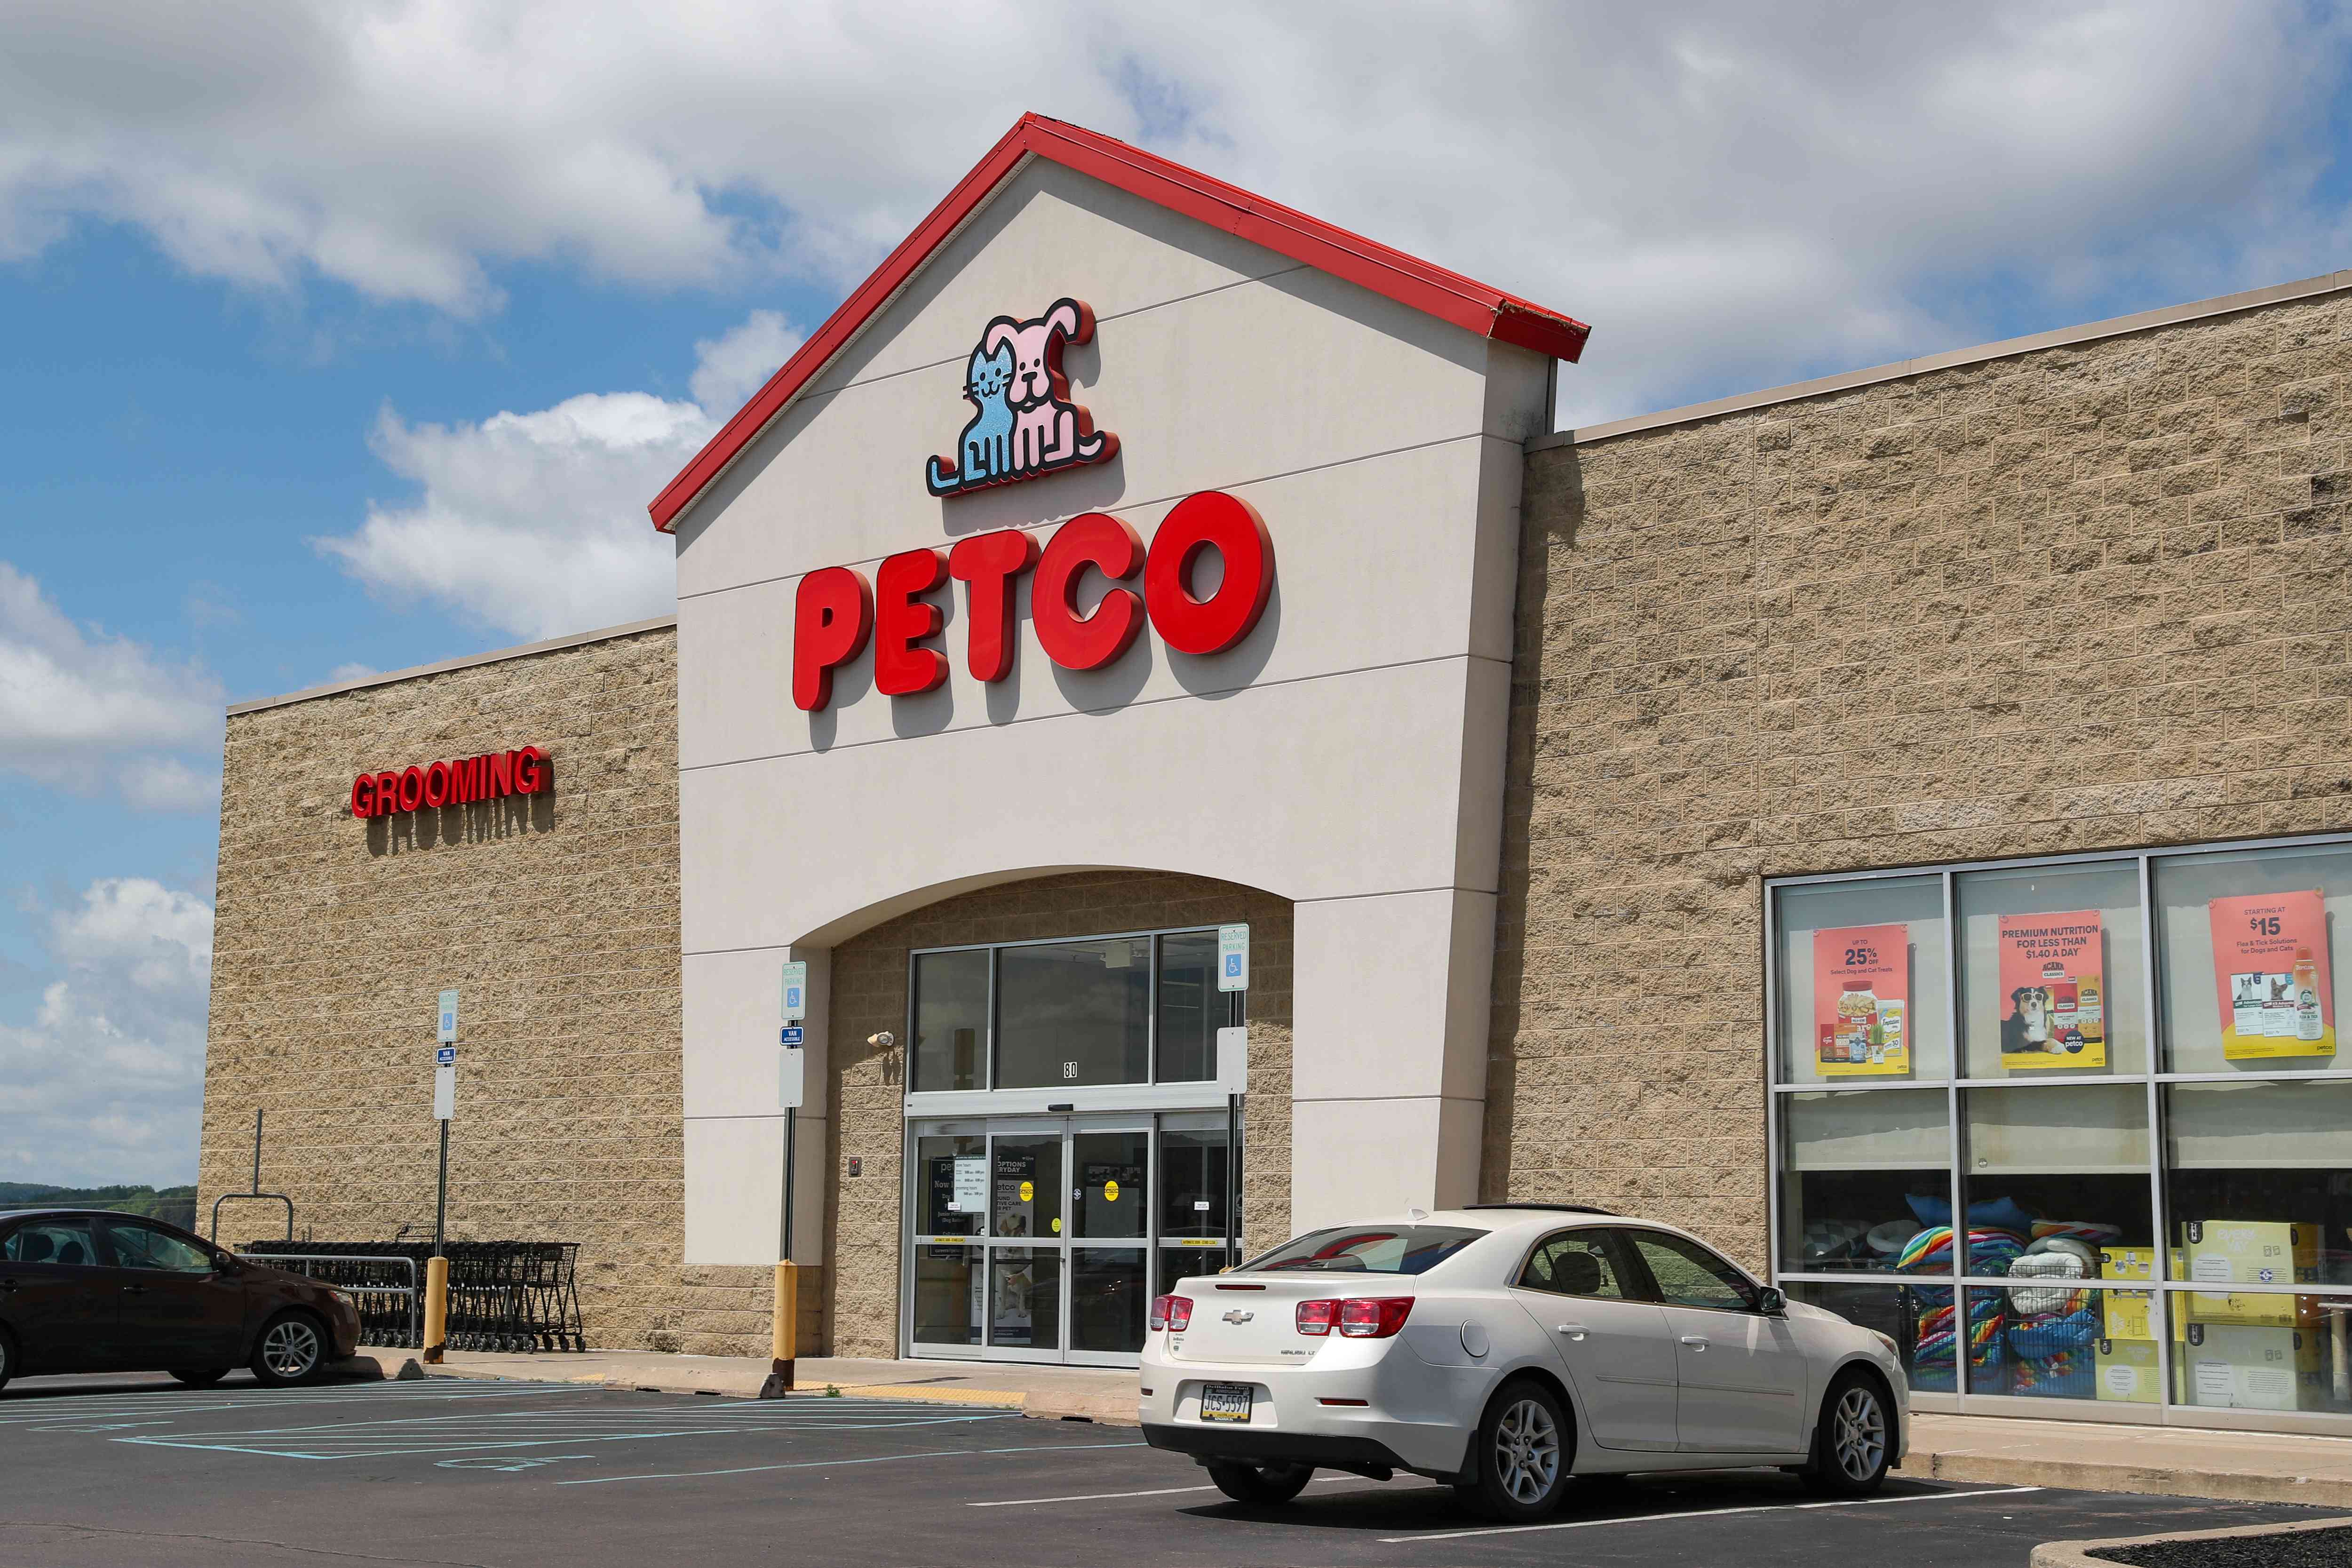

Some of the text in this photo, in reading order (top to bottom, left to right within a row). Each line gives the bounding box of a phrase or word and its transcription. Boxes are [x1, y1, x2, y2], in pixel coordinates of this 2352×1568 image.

[793, 490, 1272, 712] PETCO
[351, 746, 551, 819] GROOMING
[2002, 925, 2098, 938] PREMIUM NUTRITION
[2250, 917, 2280, 935] $15
[1221, 931, 1246, 940] RESERVED
[2038, 939, 2059, 947] LESS
[2061, 937, 2087, 946] THAN
[1223, 942, 1245, 951] PARKING
[1845, 948, 1877, 965] 25%
[2026, 949, 2050, 959] $1.40
[2052, 949, 2059, 957] A
[1065, 1063, 1076, 1077] 80
